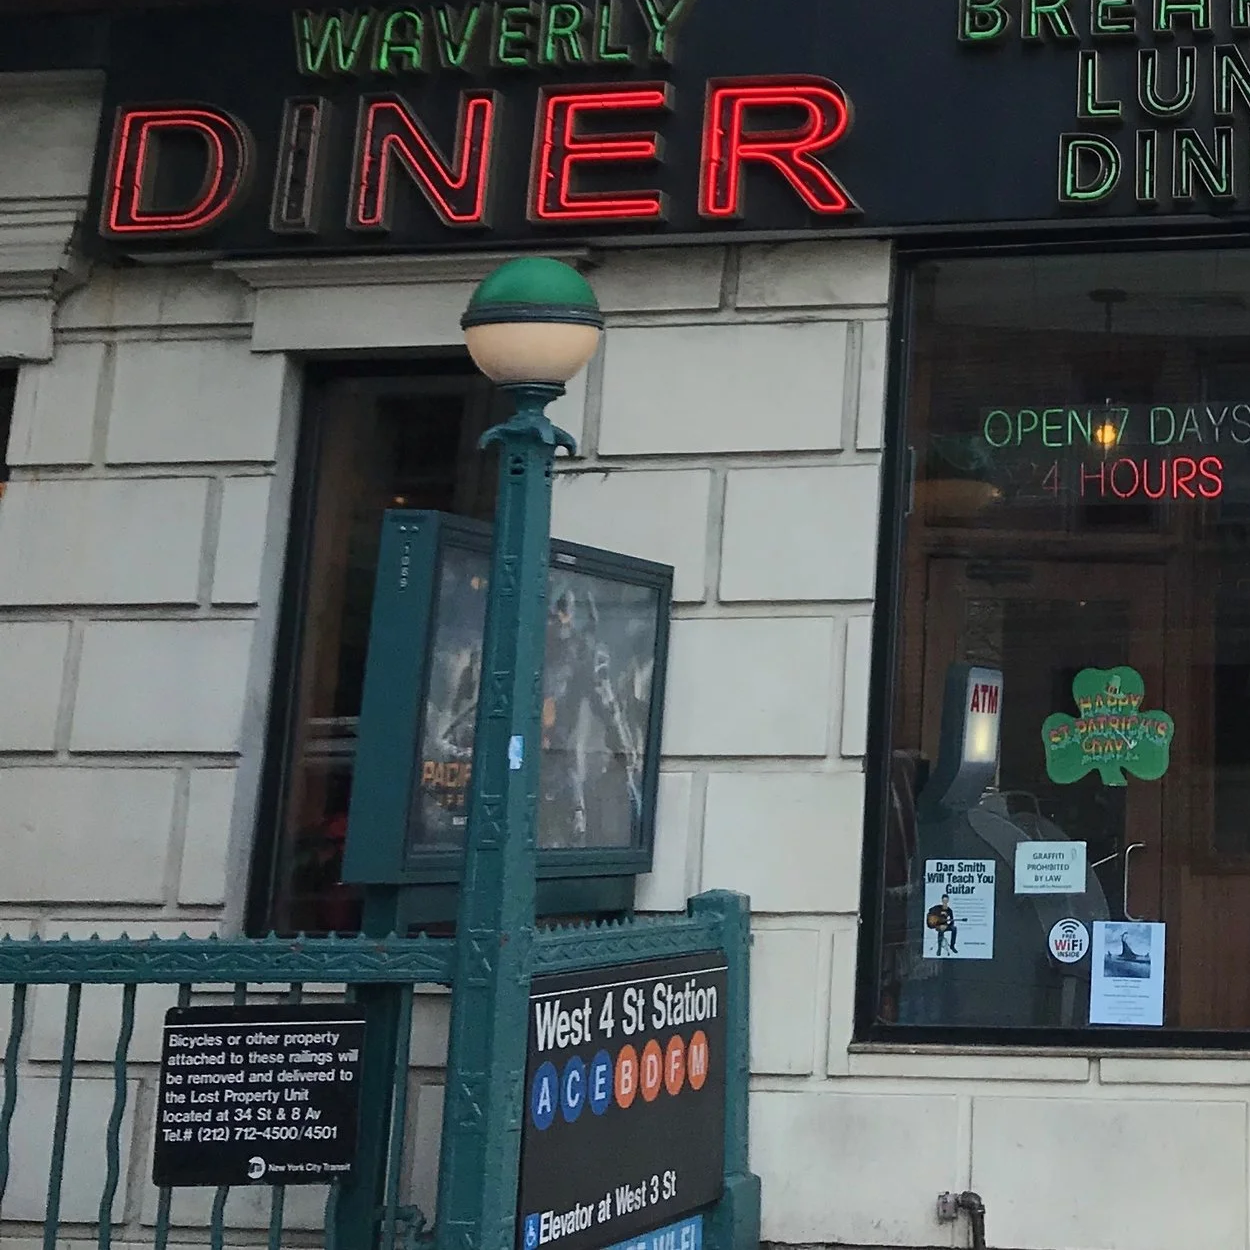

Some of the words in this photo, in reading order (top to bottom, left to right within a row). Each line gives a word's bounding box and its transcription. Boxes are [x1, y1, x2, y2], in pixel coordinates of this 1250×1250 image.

[102, 74, 864, 240] DINER
[983, 408, 1091, 448] OPEN
[1109, 407, 1129, 446] 7
[1081, 456, 1223, 499] HOURS
[971, 683, 998, 714] ATM
[1032, 852, 1065, 860] GRAFFITI
[936, 862, 954, 872] Dan
[957, 862, 986, 873] Smith
[1026, 863, 1070, 871] PROHIBITED
[927, 873, 944, 883] Will
[946, 873, 975, 884] Teach
[976, 873, 994, 884] You
[945, 884, 975, 895] Guitar
[1054, 939, 1083, 951] WiFi
[535, 997, 592, 1052] West
[599, 991, 616, 1039] 4
[621, 987, 645, 1036] St
[651, 978, 718, 1030] Station
[168, 1033, 223, 1049] Bicycles
[227, 1035, 241, 1046] or
[245, 1032, 280, 1046] other
[283, 1031, 340, 1047] property
[167, 1051, 226, 1066] attached
[230, 1052, 244, 1065] to
[248, 1051, 285, 1064] these
[288, 1050, 333, 1066] railings
[338, 1049, 359, 1062] will
[166, 1071, 183, 1085] be
[187, 1070, 245, 1085] removed
[248, 1069, 273, 1083] and
[276, 1068, 336, 1083] delivered
[339, 1069, 354, 1082] to
[537, 1076, 552, 1115] A
[566, 1069, 580, 1108] C
[594, 1064, 607, 1101] E
[620, 1059, 633, 1096] B
[646, 1053, 658, 1089] D
[670, 1049, 682, 1084] F
[690, 1043, 706, 1078] M
[165, 1091, 187, 1104] the
[190, 1089, 220, 1103] Lost
[223, 1088, 280, 1105] Property
[284, 1087, 310, 1102] Unit
[162, 1109, 213, 1123] located
[215, 1108, 230, 1122] at
[233, 1107, 252, 1121] 34
[256, 1107, 272, 1121] St
[276, 1107, 286, 1121] &
[291, 1107, 301, 1121] 8
[304, 1107, 322, 1120] Av
[162, 1128, 193, 1143] Tel.#
[197, 1126, 230, 1143] (212)
[234, 1125, 339, 1141] 712-4500/4501
[268, 1163, 286, 1172] New
[287, 1162, 305, 1171] York
[305, 1162, 322, 1174] City
[323, 1162, 351, 1171] Transit
[539, 1203, 595, 1246] Elevator
[597, 1192, 612, 1224] at
[615, 1180, 647, 1217] West
[650, 1174, 660, 1205] 3
[662, 1170, 677, 1200] St
